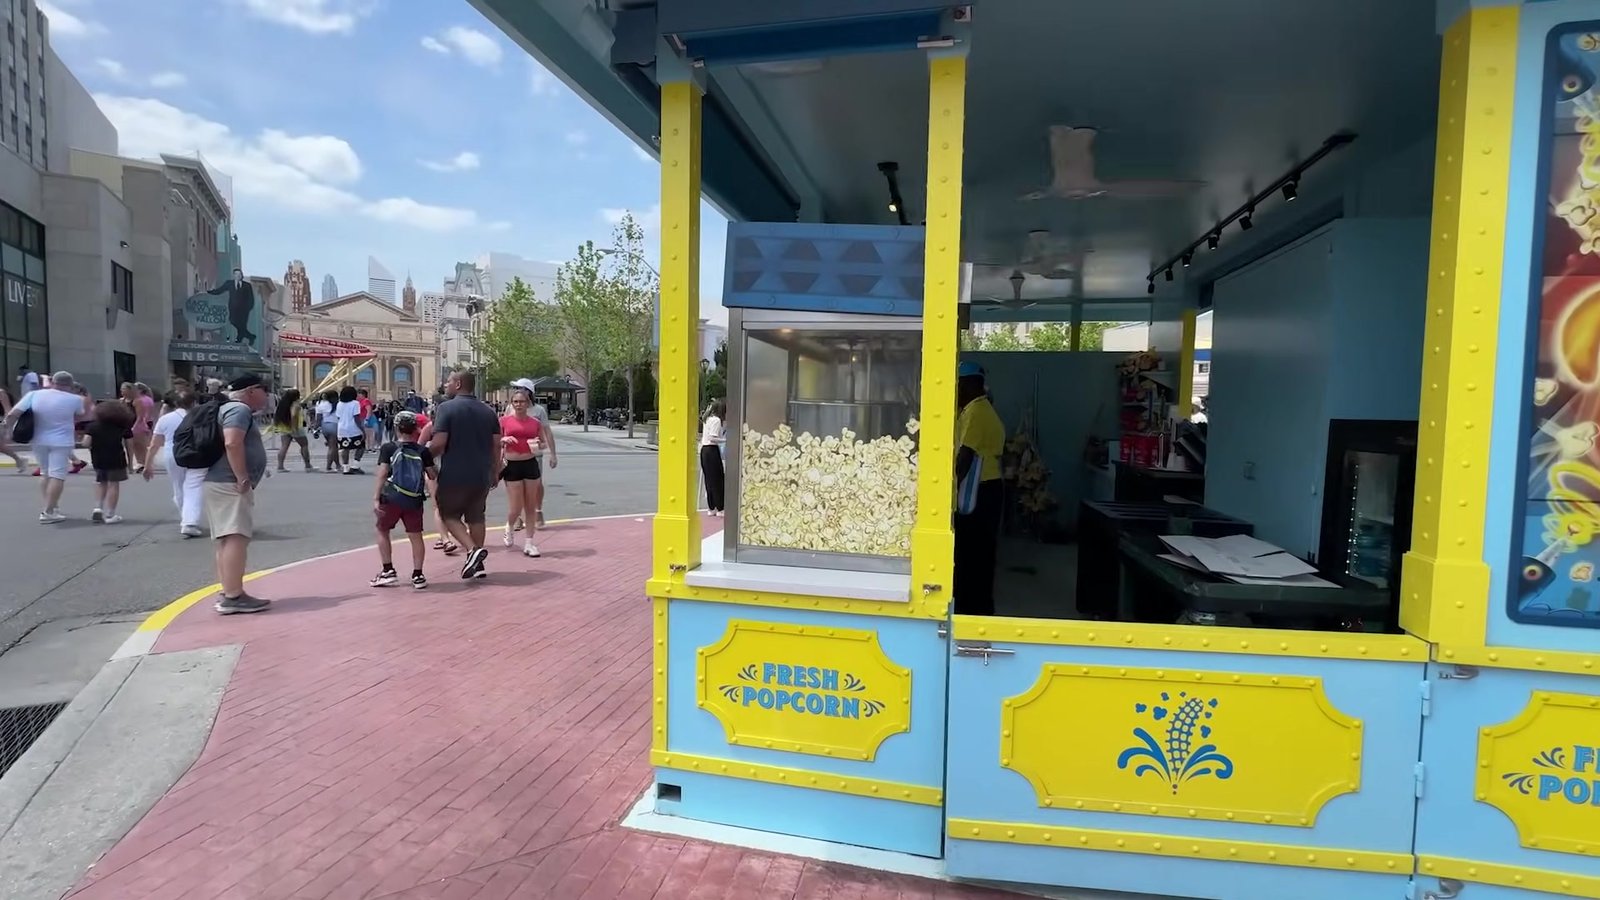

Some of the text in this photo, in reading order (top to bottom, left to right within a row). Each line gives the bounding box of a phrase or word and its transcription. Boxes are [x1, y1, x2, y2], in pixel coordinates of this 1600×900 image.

[182, 351, 219, 361] NBC
[763, 663, 839, 690] FRESH
[742, 686, 860, 719] POPCORN
